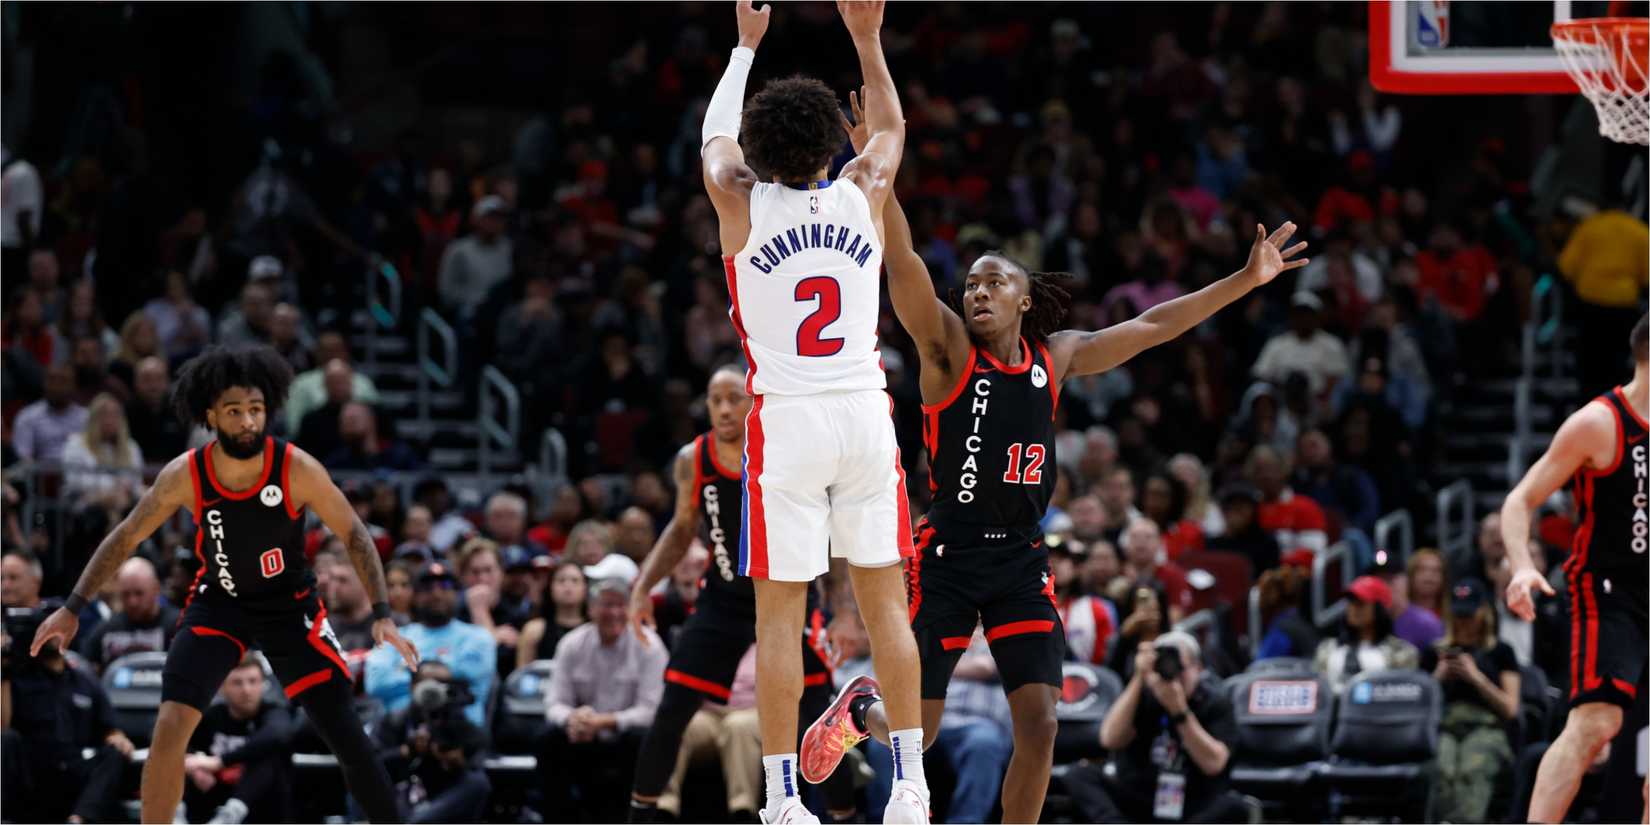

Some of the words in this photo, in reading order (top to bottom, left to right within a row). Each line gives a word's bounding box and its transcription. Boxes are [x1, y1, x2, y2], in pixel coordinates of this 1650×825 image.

[750, 223, 872, 275] CUNNINGHAM
[794, 275, 845, 357] 2
[957, 378, 991, 504] CHICAGO
[1003, 442, 1046, 485] 12
[703, 484, 734, 582] CHICAGO
[1631, 445, 1648, 554] CHICAGO
[207, 509, 238, 598] CHICAG
[260, 547, 285, 579] 0
